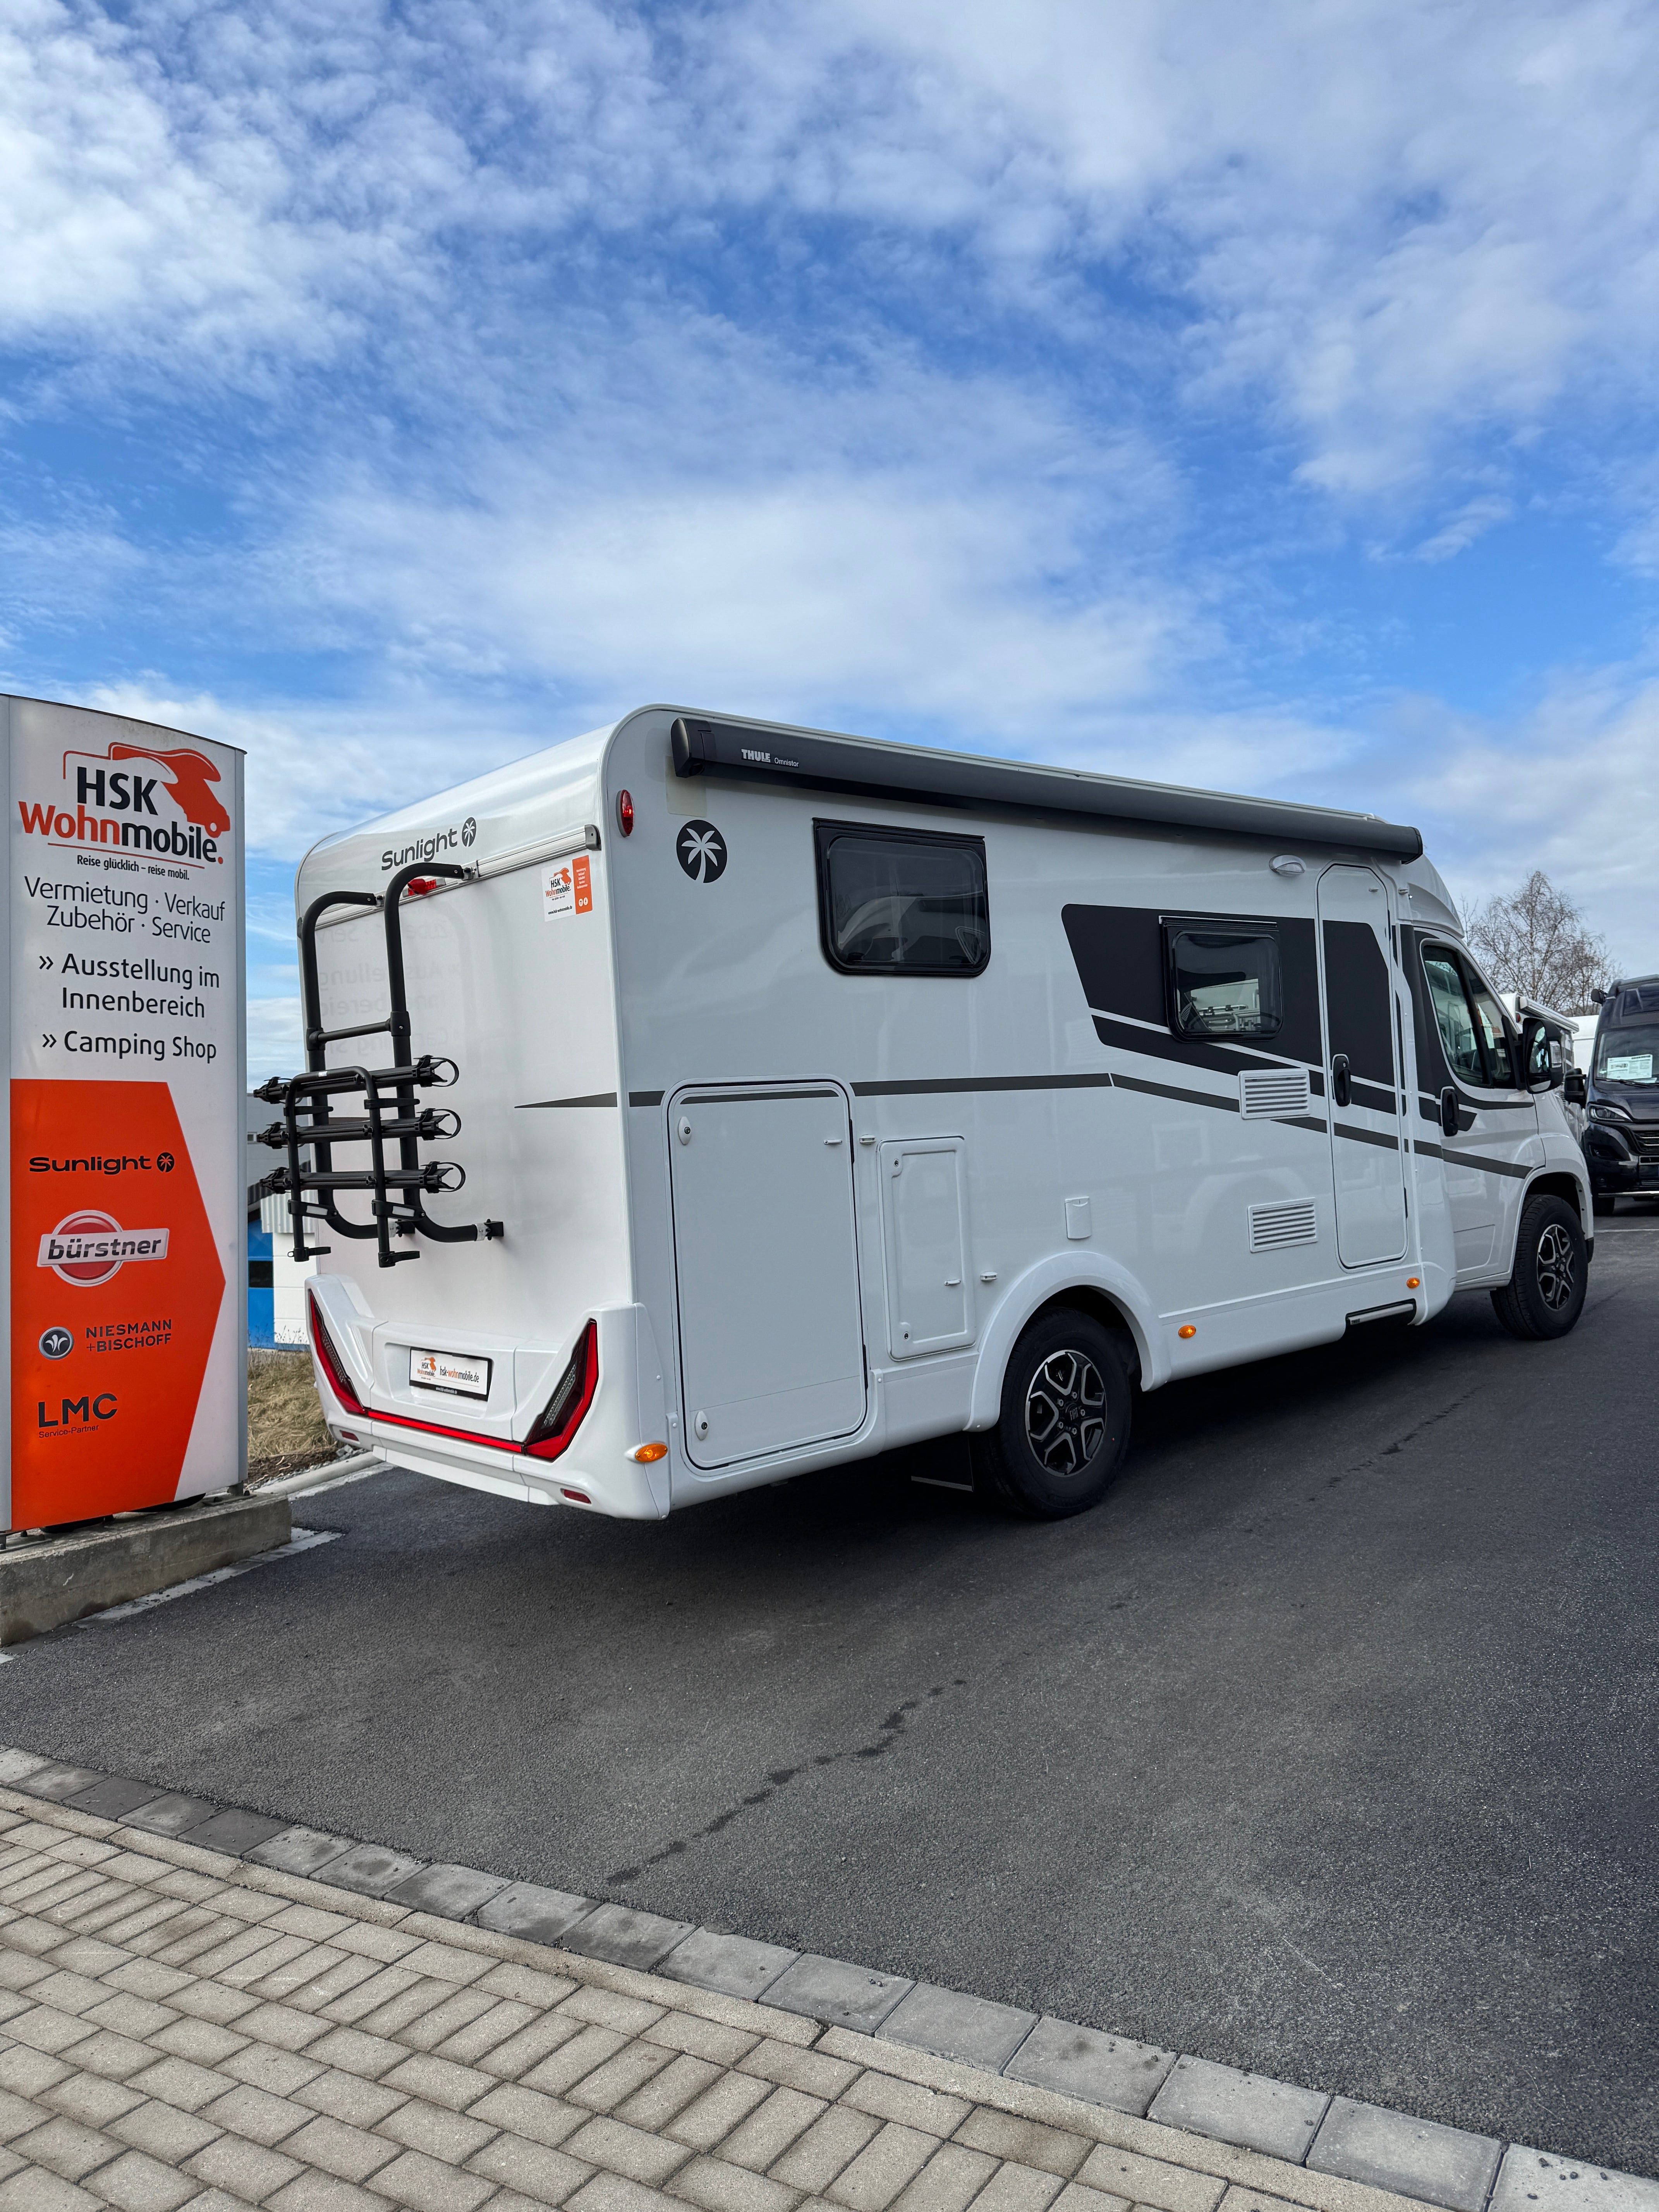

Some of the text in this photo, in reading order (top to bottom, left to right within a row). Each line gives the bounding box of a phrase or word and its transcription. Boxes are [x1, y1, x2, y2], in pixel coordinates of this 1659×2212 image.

[741, 749, 799, 767] THULE Omnistor
[77, 766, 158, 816] HSK
[19, 801, 223, 865] Wohnmobile.
[381, 828, 457, 871] Sunlight
[77, 855, 100, 867] Reise
[104, 858, 139, 872] glücklich
[148, 866, 165, 876] reise
[168, 869, 189, 880] mobil.
[551, 878, 561, 888] HSK
[24, 876, 225, 921] Vermietung Verkauf
[46, 905, 210, 943] Zubehör Service
[61, 953, 219, 990] Ausstellung im
[63, 987, 205, 1018] Innenbereich
[64, 1030, 216, 1063] Camping Shop
[29, 1156, 152, 1175] Sunlight
[48, 1238, 161, 1260] bürstner
[86, 1319, 172, 1338] NIESMANN
[86, 1333, 171, 1352] +BISCHOFF
[440, 1365, 479, 1382] hsk-wohnmobile.de
[38, 1393, 117, 1428] LMC
[39, 1424, 99, 1438] Service-Partner
